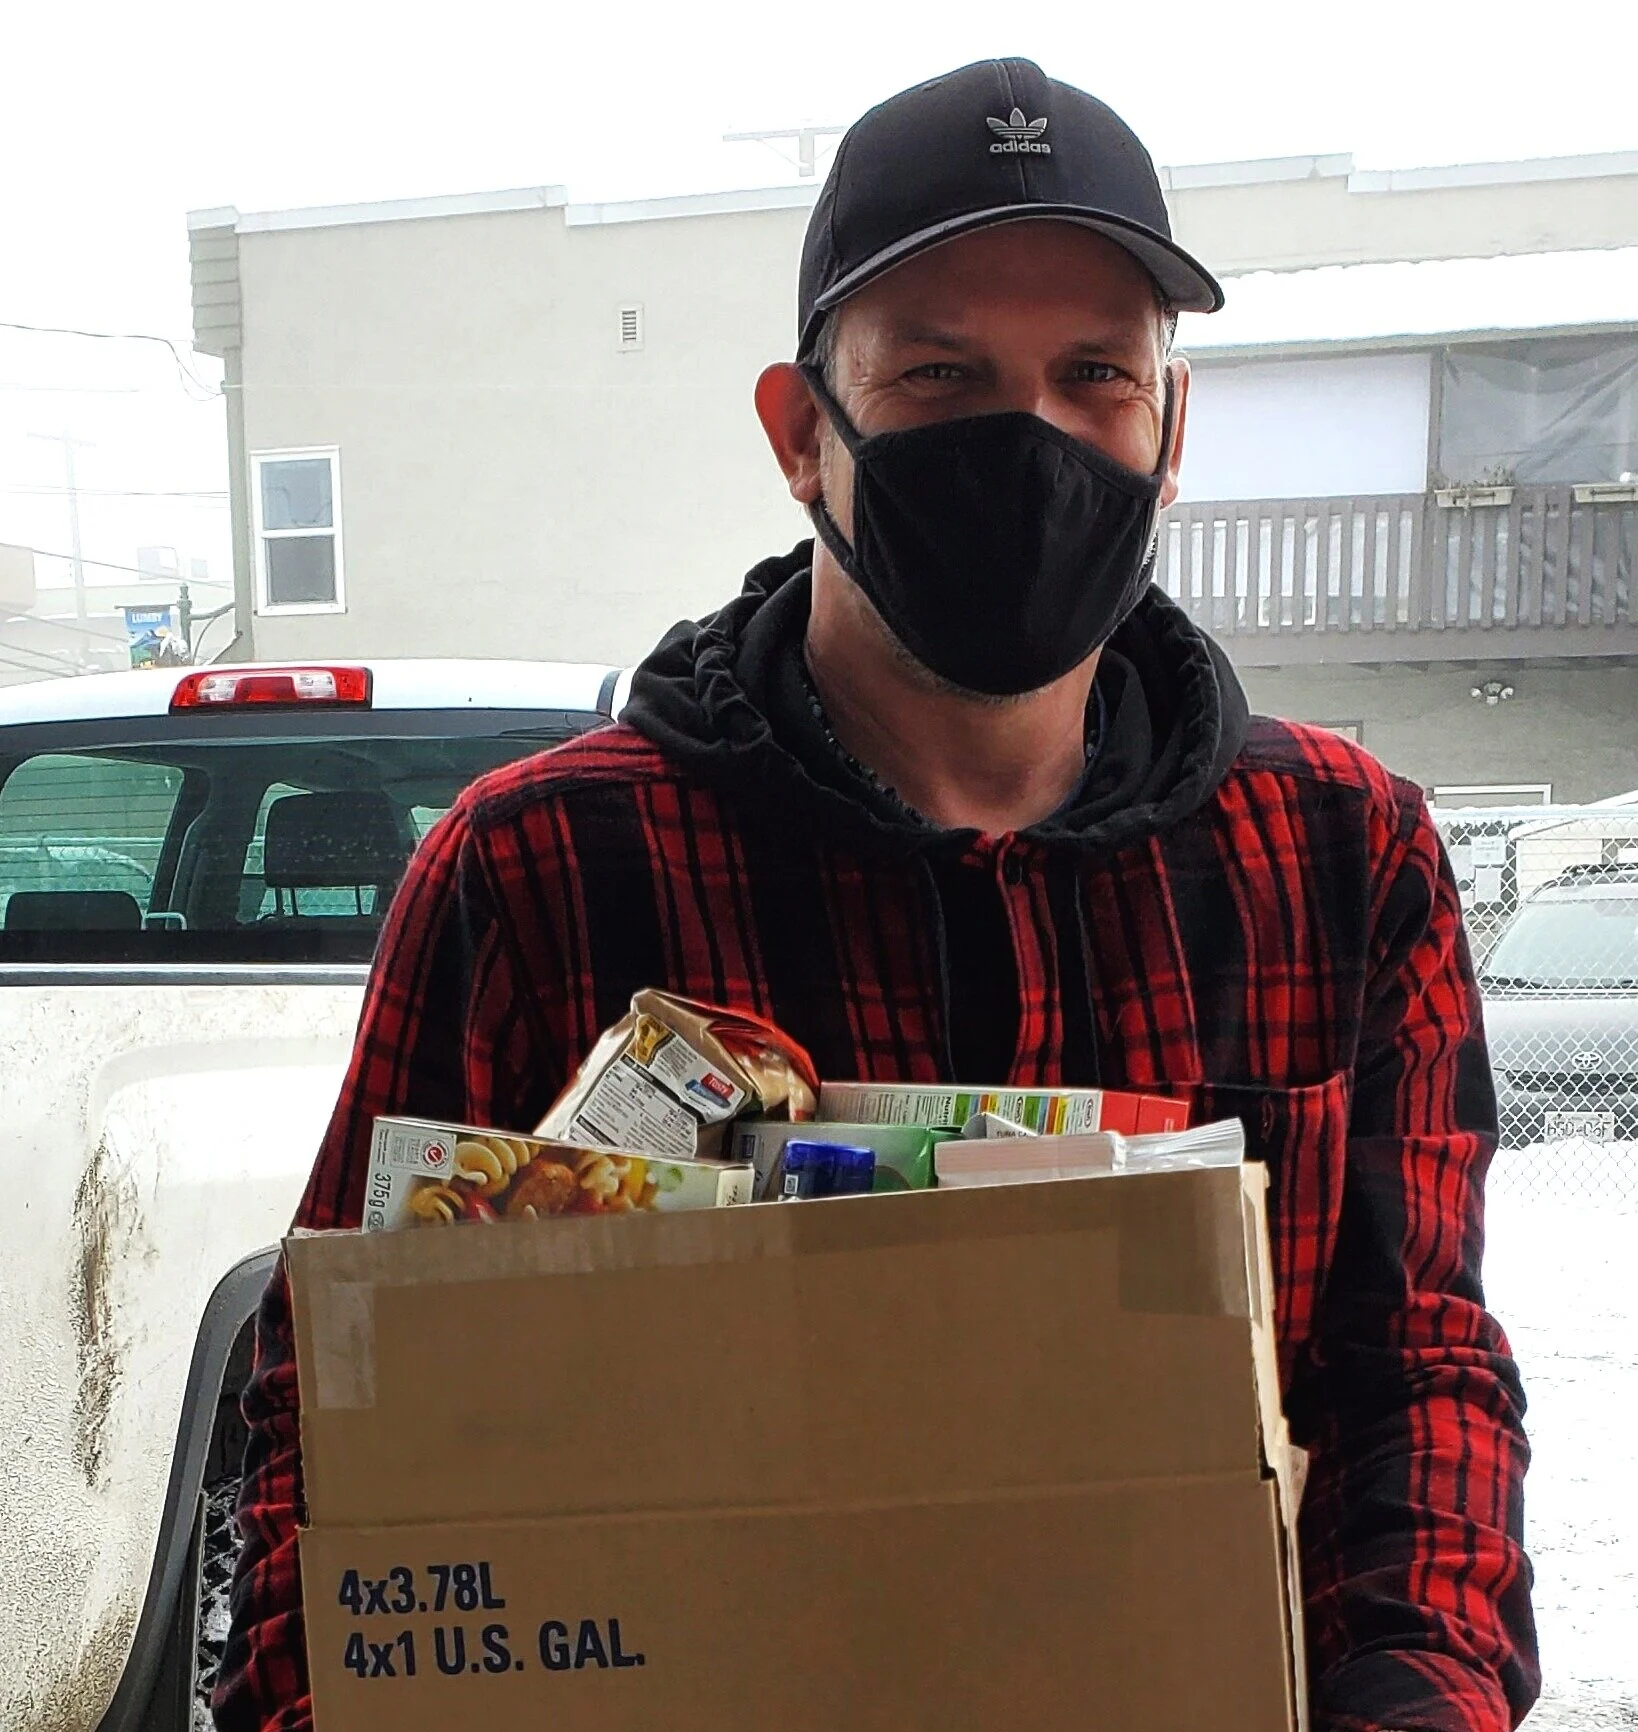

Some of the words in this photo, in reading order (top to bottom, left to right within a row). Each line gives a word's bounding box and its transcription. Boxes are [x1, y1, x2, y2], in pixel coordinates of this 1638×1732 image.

[989, 140, 1051, 154] adidas
[339, 1562, 506, 1615] 4x3.78L
[344, 1630, 416, 1678] 4x1
[434, 1624, 524, 1676] U.S.
[538, 1618, 645, 1671] GAL.
